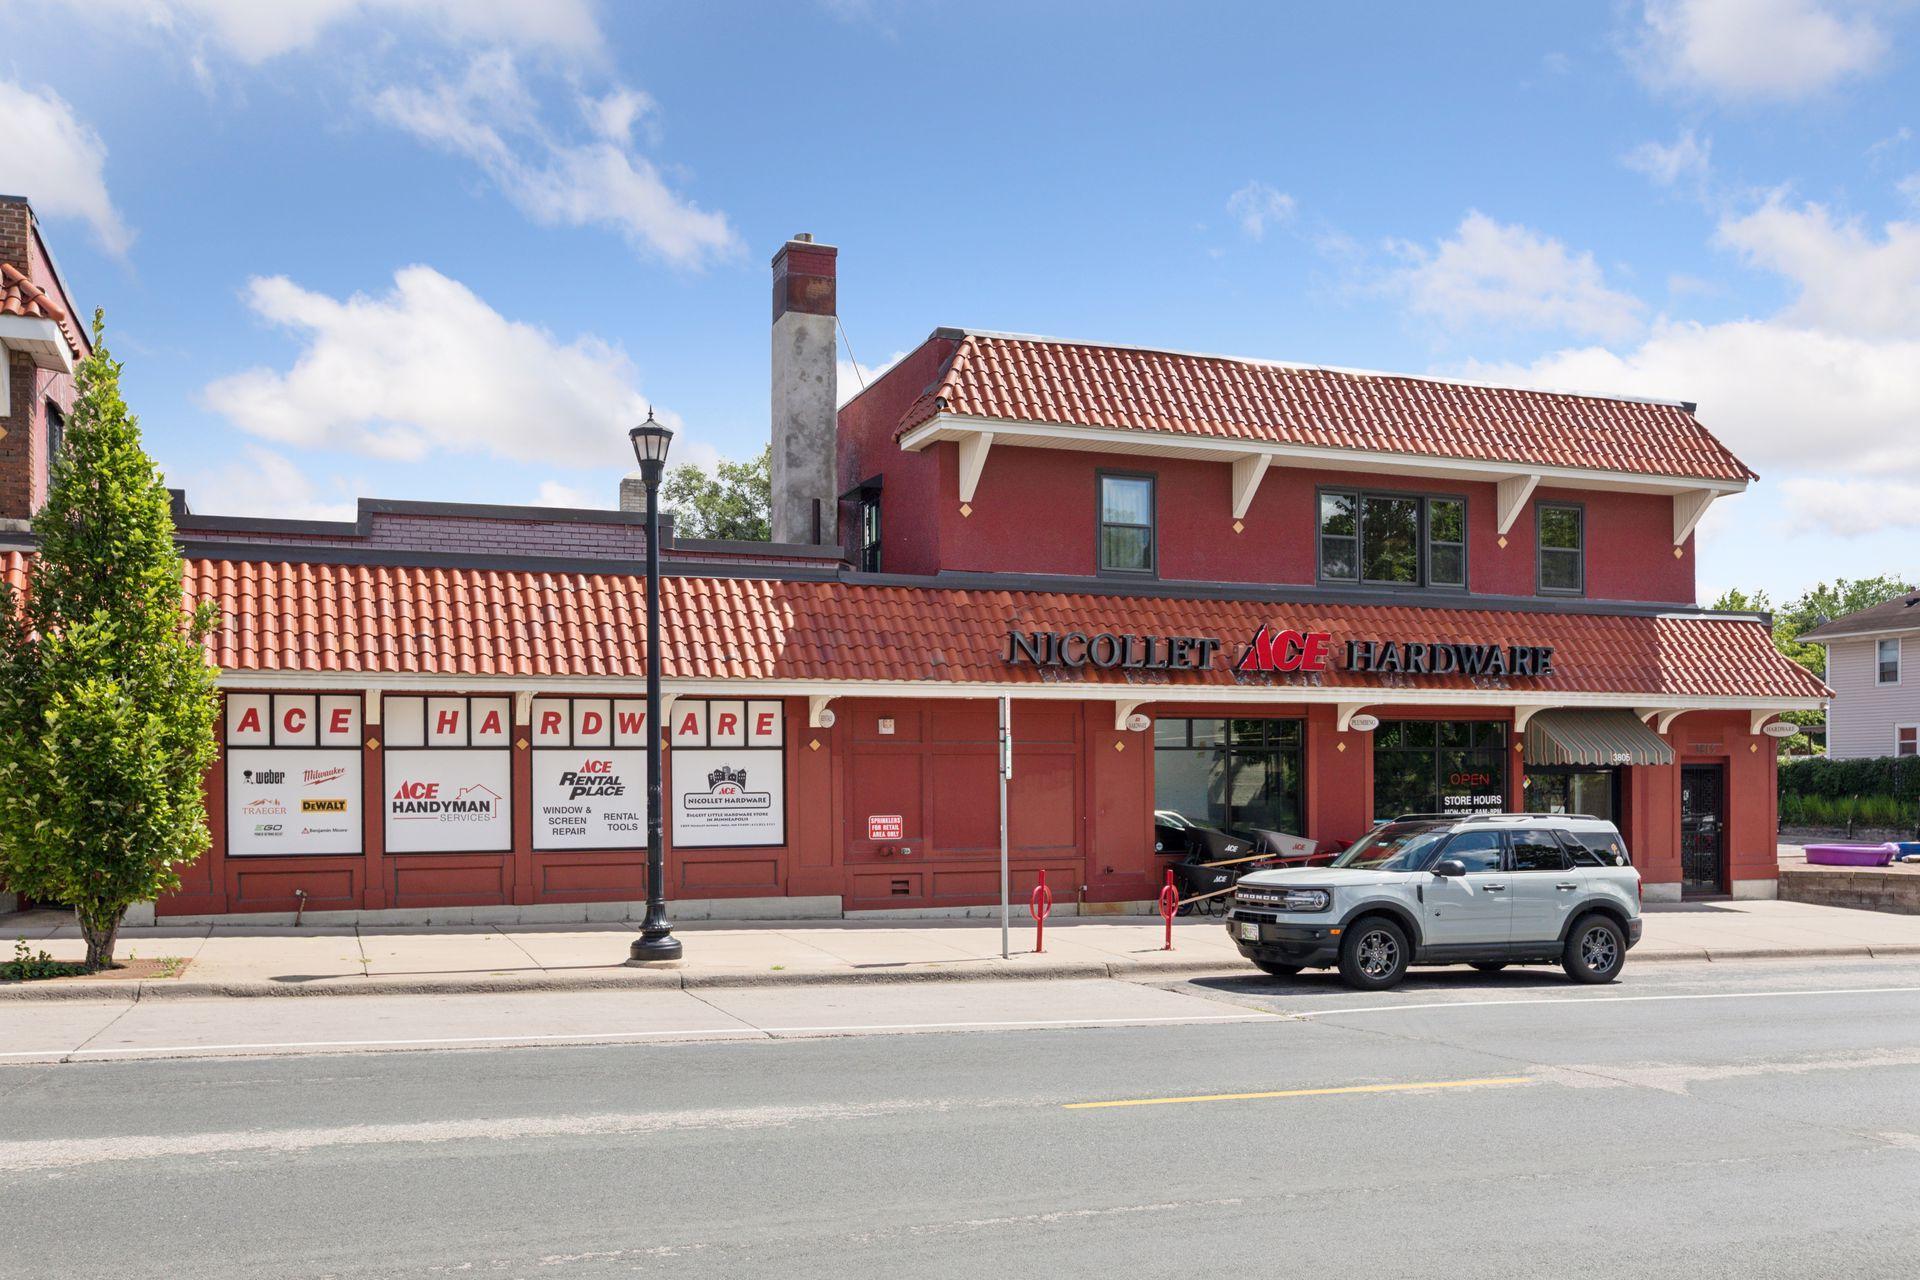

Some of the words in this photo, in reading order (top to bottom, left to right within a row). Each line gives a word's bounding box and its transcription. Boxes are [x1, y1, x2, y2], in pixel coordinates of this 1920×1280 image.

[1008, 630, 1220, 670] NICOLLET
[1237, 623, 1331, 672] ACE
[1344, 640, 1556, 676] HARDWARE
[237, 708, 352, 733] ACE
[1612, 753, 1631, 762] 3805
[579, 759, 612, 773] ACE
[255, 769, 285, 784] weber
[303, 767, 345, 782] Milwaukee
[559, 772, 622, 786] RENTAL
[1450, 773, 1490, 786] OPEN
[393, 780, 439, 799] ACE
[569, 786, 625, 800] PLACE
[1444, 796, 1471, 805] STORE
[1474, 795, 1502, 805] HOURS
[242, 807, 287, 815] TRAEGER
[392, 801, 490, 813] HANDYMAN
[543, 806, 583, 814] WINDOW
[585, 806, 592, 814] &
[440, 814, 490, 822] SERVICES
[549, 817, 587, 825] SCREEN
[603, 813, 639, 821] RENTAL
[552, 827, 586, 836] REPAIR
[607, 823, 638, 831] TOOLS
[1225, 844, 1238, 853] ACE
[1213, 875, 1228, 883] ACE
